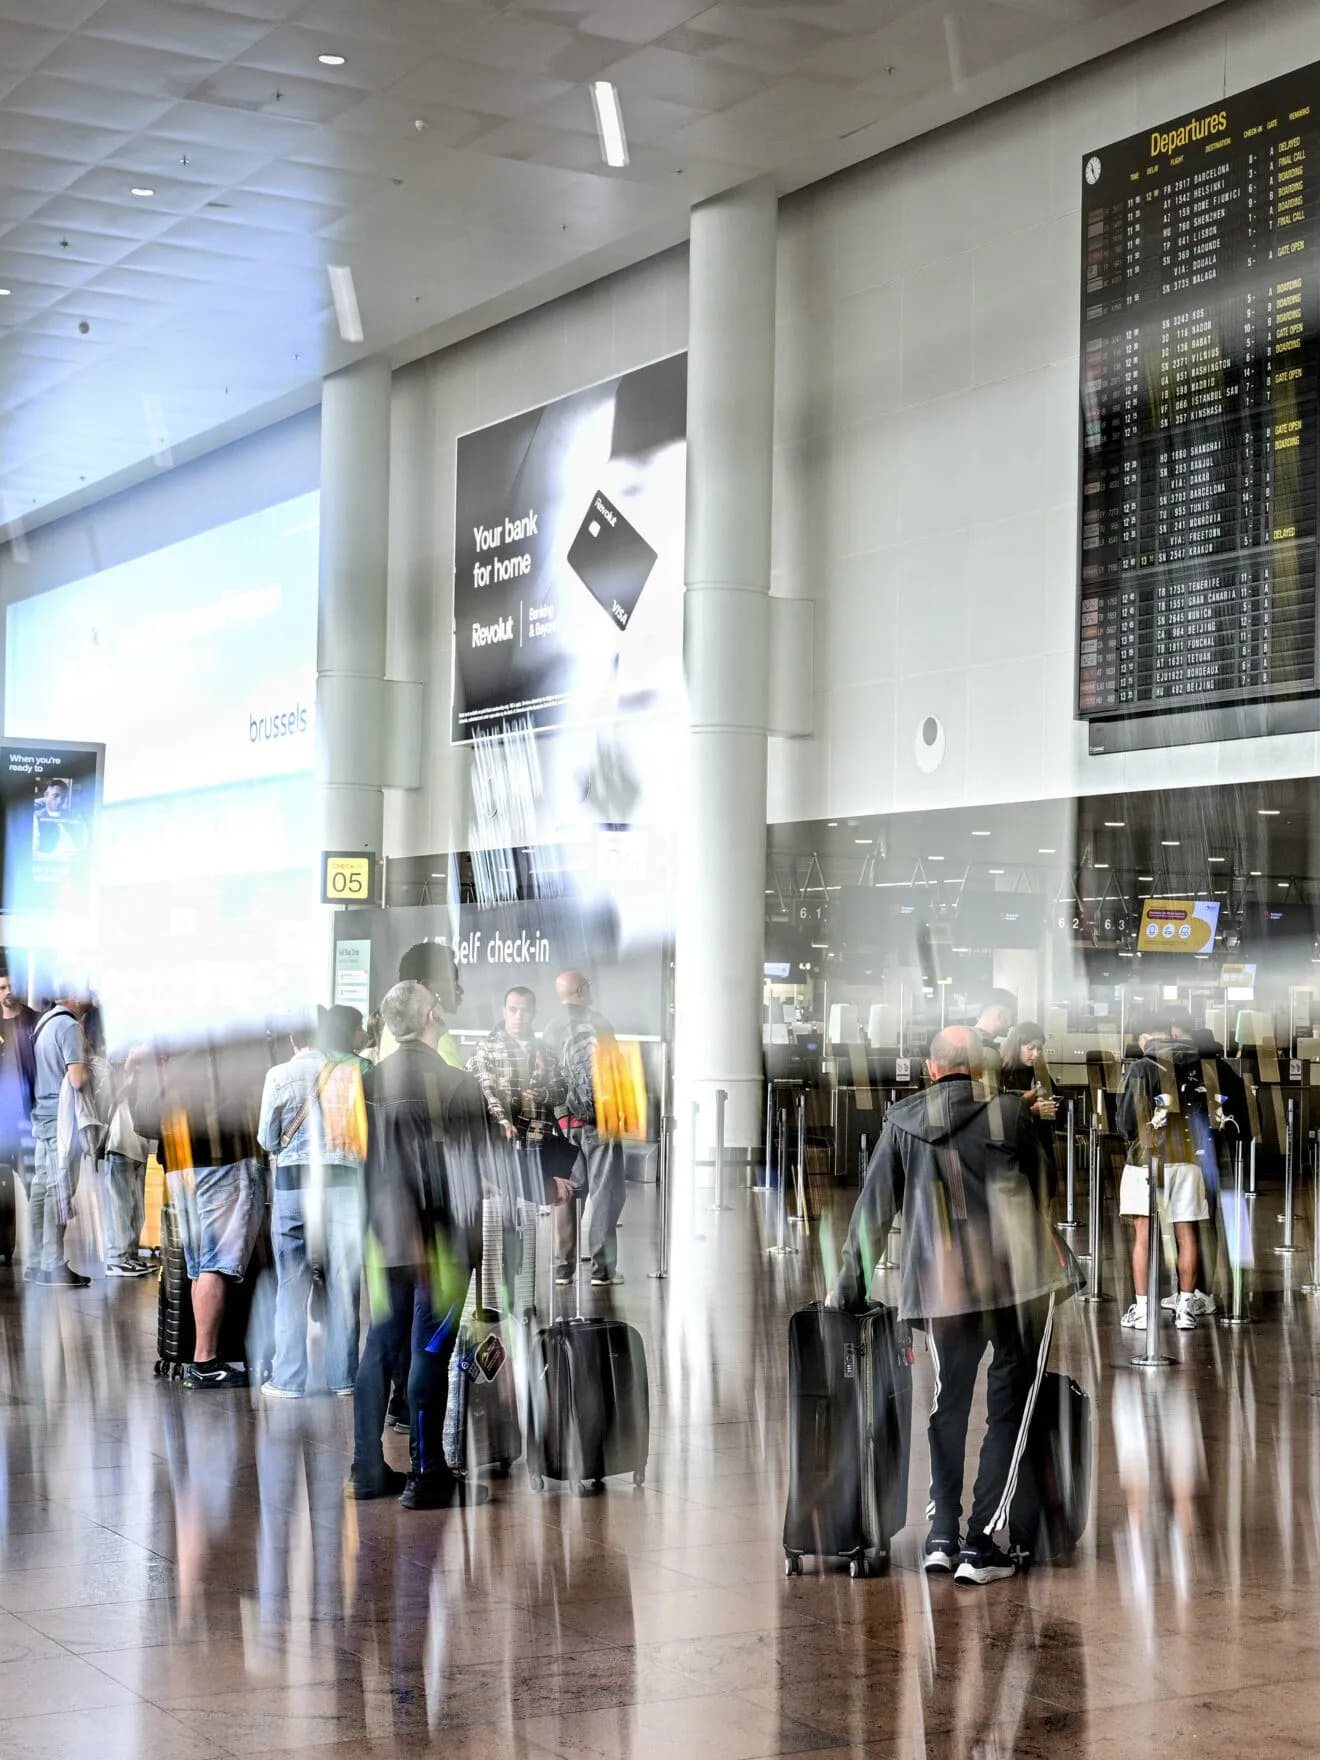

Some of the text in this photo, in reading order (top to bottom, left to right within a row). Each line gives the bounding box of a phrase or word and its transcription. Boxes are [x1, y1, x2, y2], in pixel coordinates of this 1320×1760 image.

[1151, 111, 1227, 156] Departures
[1170, 155, 1183, 165] FLIGHT
[1267, 119, 1277, 129] GATE
[1293, 150, 1306, 161] CALL
[1194, 163, 1229, 184] BARCELONA
[1194, 181, 1224, 198] HELSINKI
[1194, 209, 1225, 227] SHENZHEN
[1194, 226, 1217, 241] LISBON
[1190, 484, 1225, 499] BARCELONA
[595, 498, 617, 527] Revolut
[1190, 501, 1209, 513] TUNIS
[474, 509, 538, 552] Your bank
[1274, 526, 1295, 540] DELAYED
[473, 554, 531, 588] for home
[612, 600, 628, 625] VISA
[472, 616, 513, 648] Revolut
[249, 703, 308, 743] brussels
[9, 764, 32, 774] ready
[10, 754, 61, 765] When you're
[332, 872, 362, 892] 05
[453, 930, 549, 964] Self check-in
